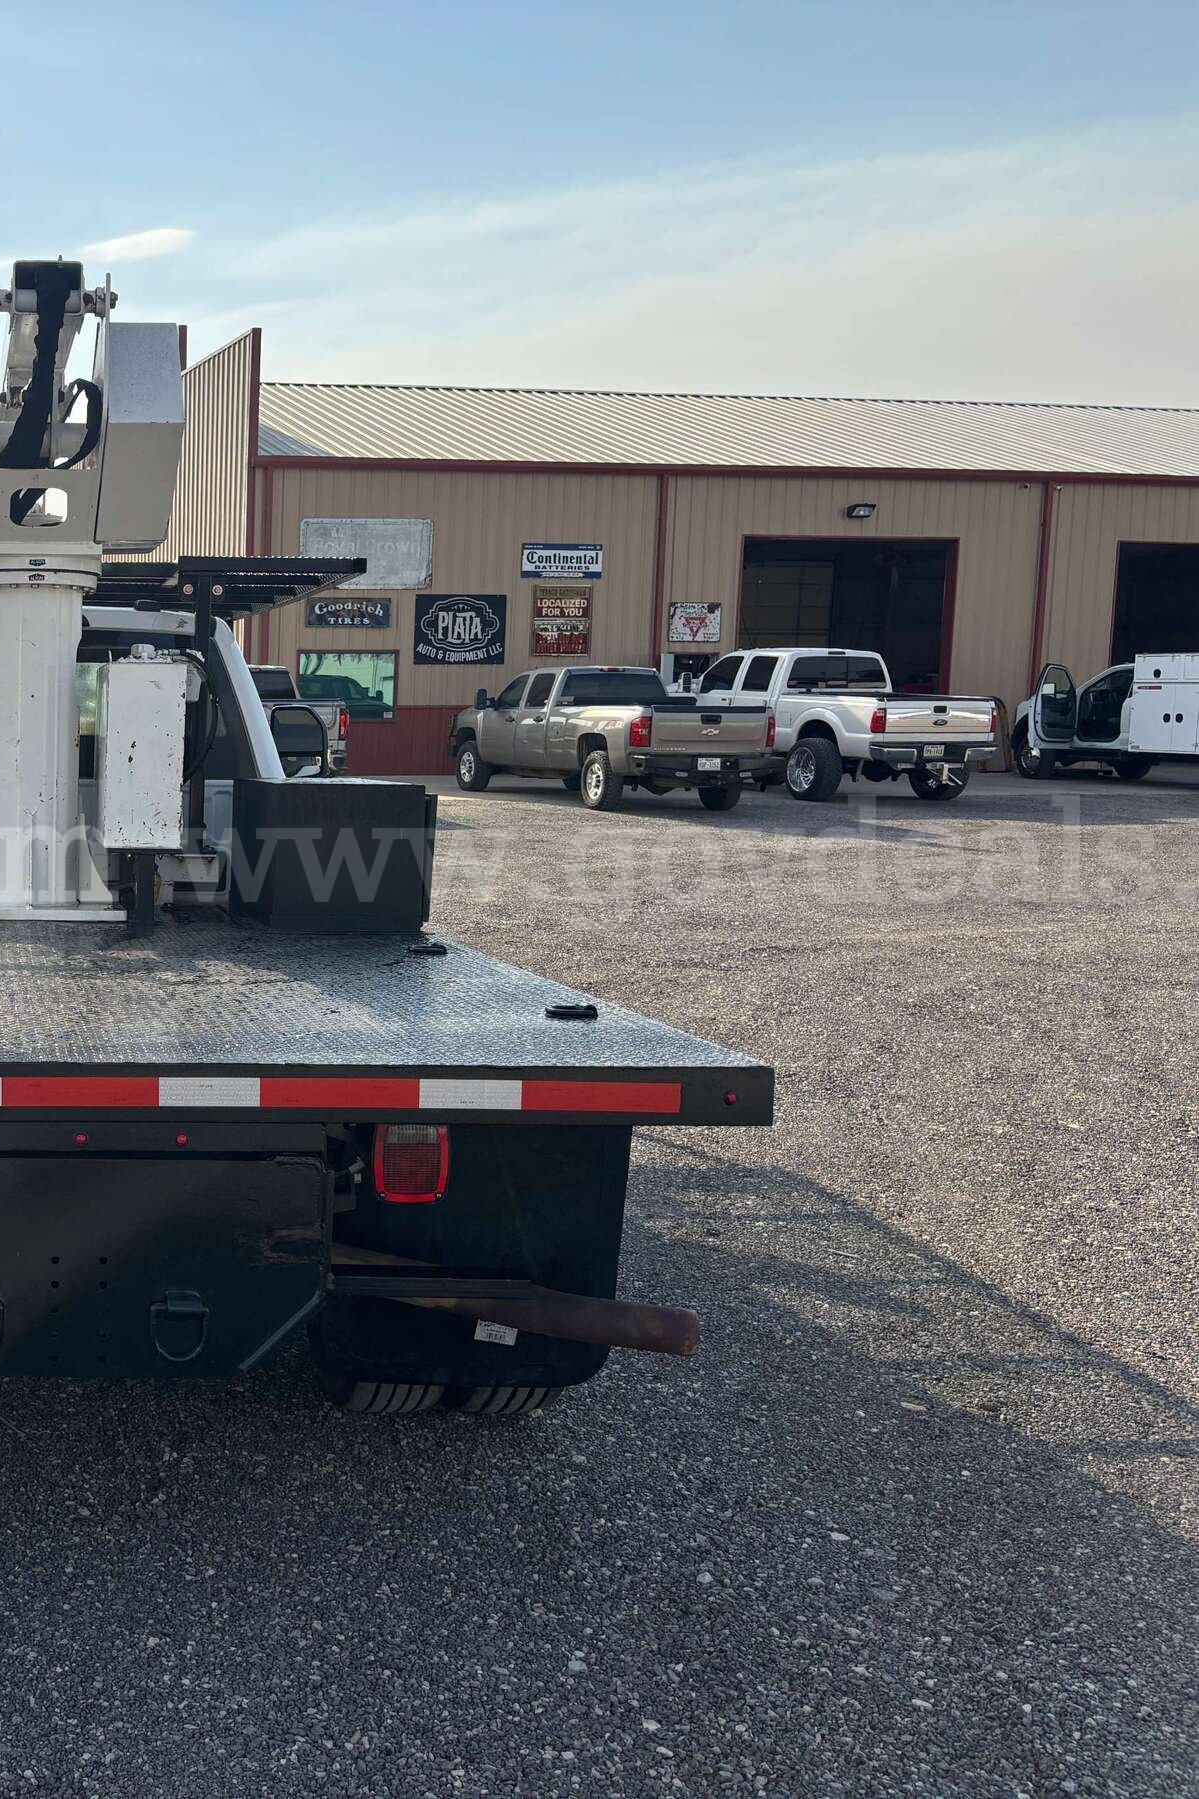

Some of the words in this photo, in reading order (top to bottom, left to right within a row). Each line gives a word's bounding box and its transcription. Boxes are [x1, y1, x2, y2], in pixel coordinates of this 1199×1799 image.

[526, 551, 598, 565] Continental
[314, 601, 383, 616] Goodrich
[537, 599, 588, 608] LOCALIZED
[542, 608, 560, 616] FOR
[563, 608, 583, 616] YOU
[328, 617, 370, 625] TIRES
[437, 611, 482, 643] PLATA
[416, 643, 436, 658] AUTO
[437, 650, 444, 659] &
[445, 648, 487, 662] EQUIPMENT
[488, 642, 503, 656] LLC
